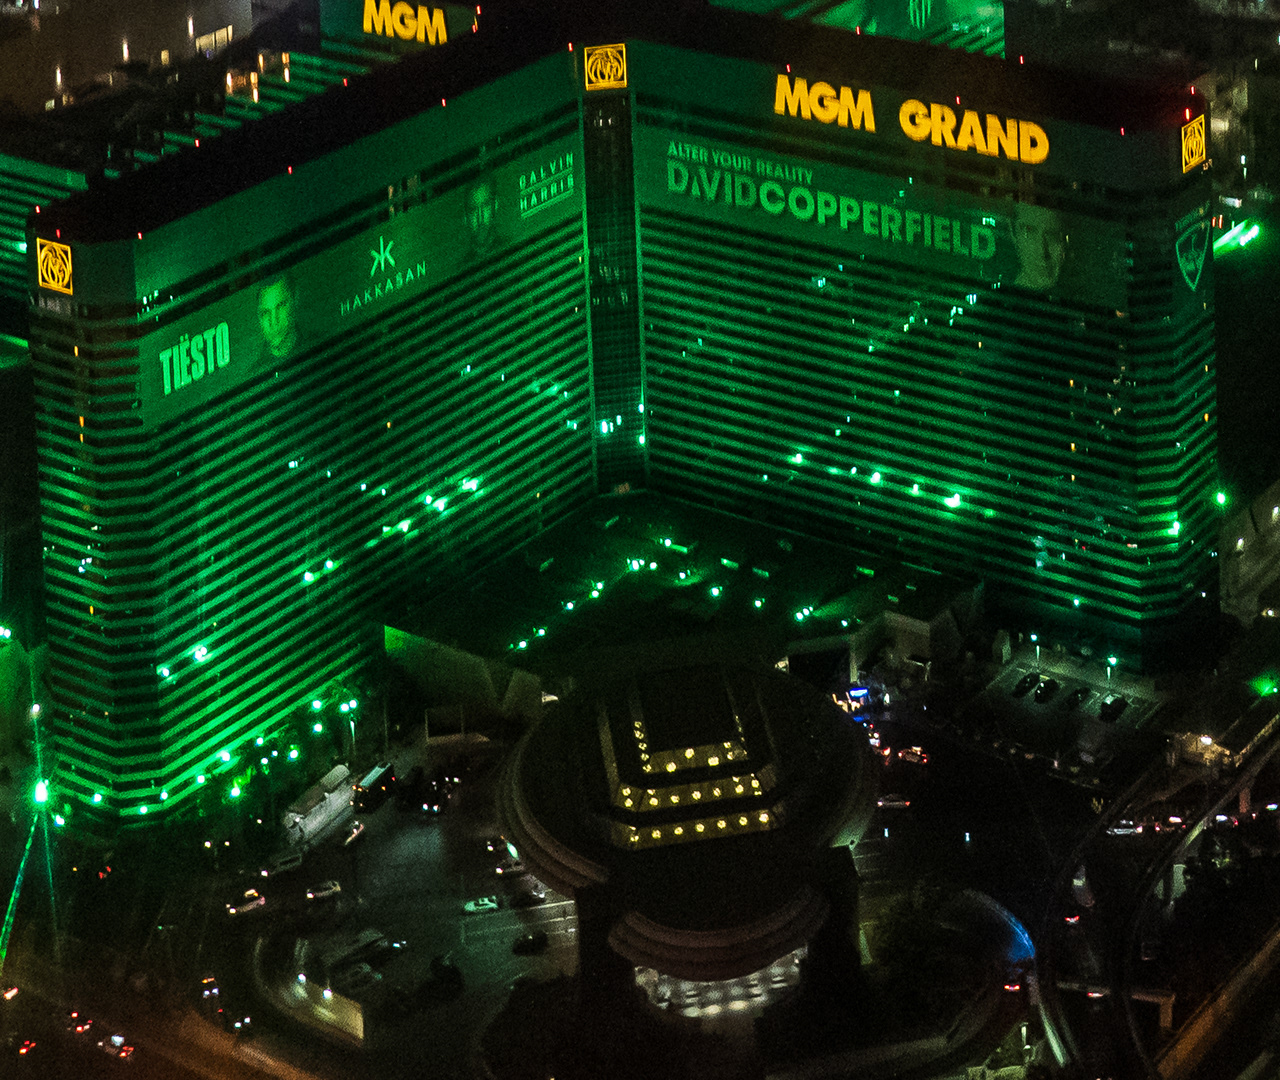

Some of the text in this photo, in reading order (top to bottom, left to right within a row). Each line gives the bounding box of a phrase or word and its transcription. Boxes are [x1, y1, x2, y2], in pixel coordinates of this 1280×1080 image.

[774, 73, 1050, 165] MGM GRAND
[519, 152, 574, 190] CALVIN
[668, 140, 813, 184] ALTER YOUR REALITY
[519, 173, 574, 211] HARRIS
[340, 260, 428, 317] HAKKASAN
[159, 322, 231, 395] TIËSTO
